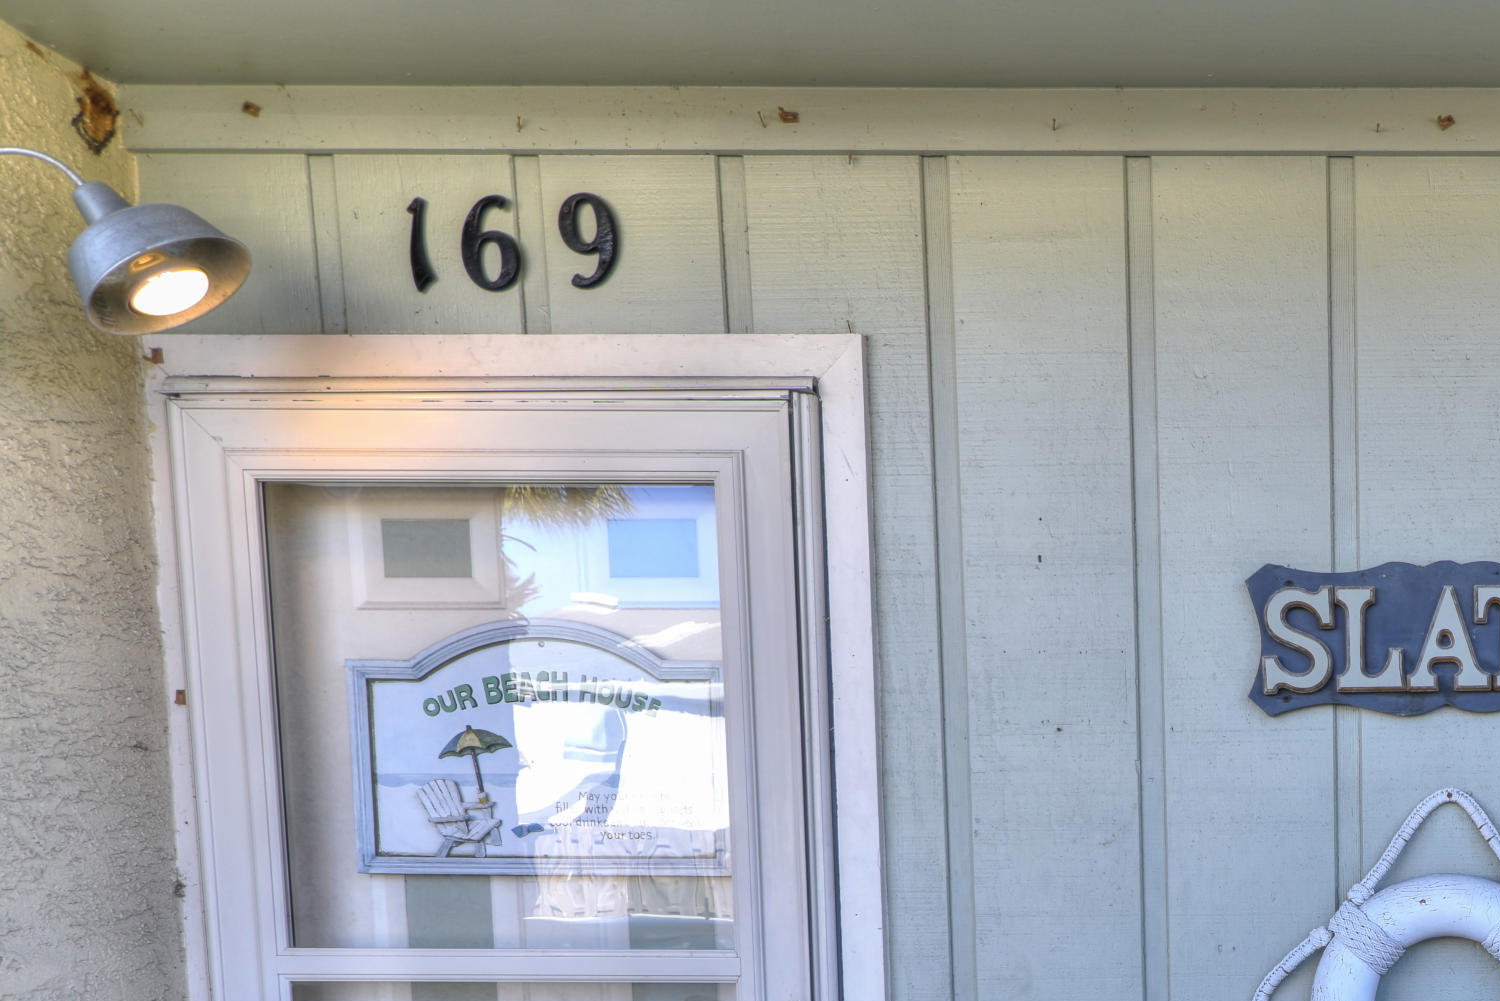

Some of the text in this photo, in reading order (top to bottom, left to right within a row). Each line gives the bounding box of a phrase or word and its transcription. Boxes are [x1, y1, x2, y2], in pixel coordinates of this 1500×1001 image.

[406, 192, 618, 293] 169
[422, 670, 662, 718] OUR BEACH HOUSE
[578, 791, 600, 803] May
[584, 803, 608, 814] with
[600, 831, 625, 842] your
